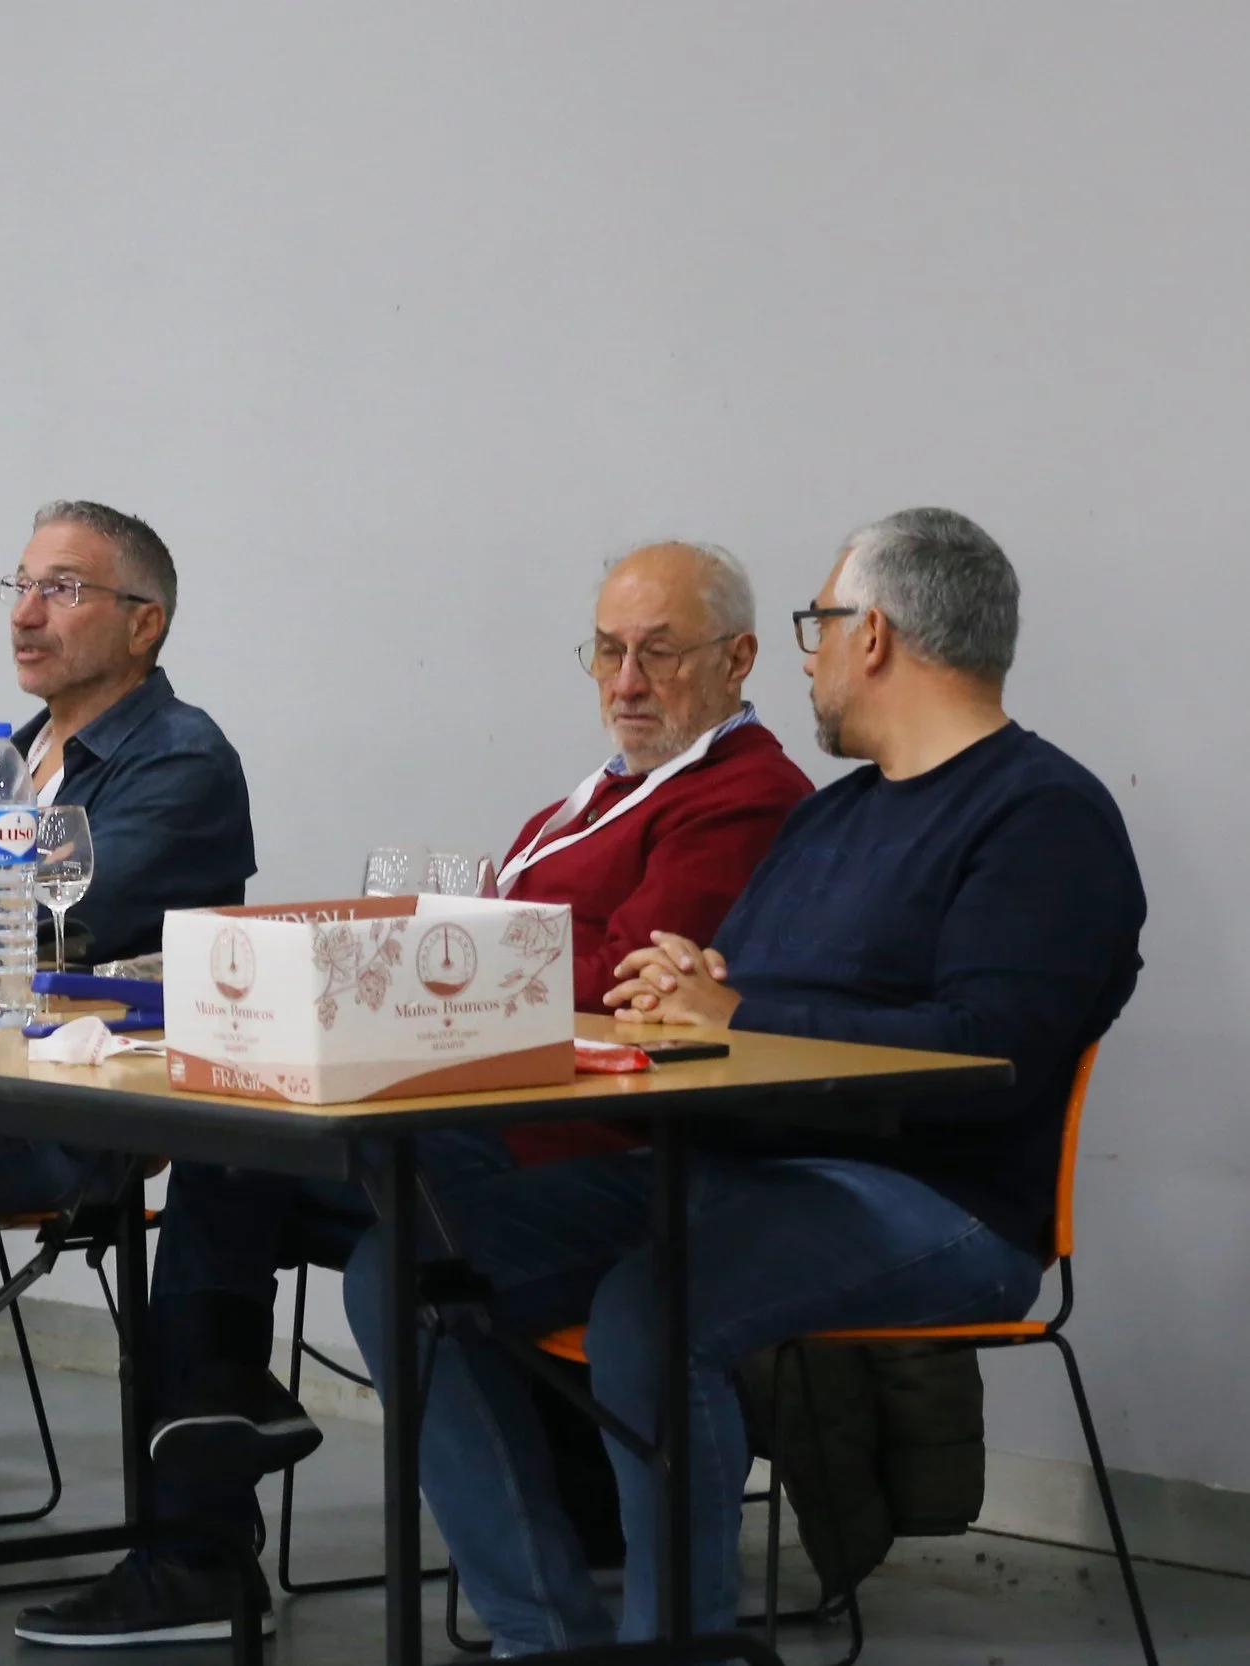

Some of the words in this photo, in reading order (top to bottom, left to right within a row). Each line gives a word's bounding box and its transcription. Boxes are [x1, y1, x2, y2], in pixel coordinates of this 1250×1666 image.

[0, 827, 33, 841] LUSO
[195, 1000, 227, 1016] Matos
[230, 1003, 274, 1020] Brancos
[395, 1003, 438, 1018] Matos
[443, 1000, 500, 1015] Brancos
